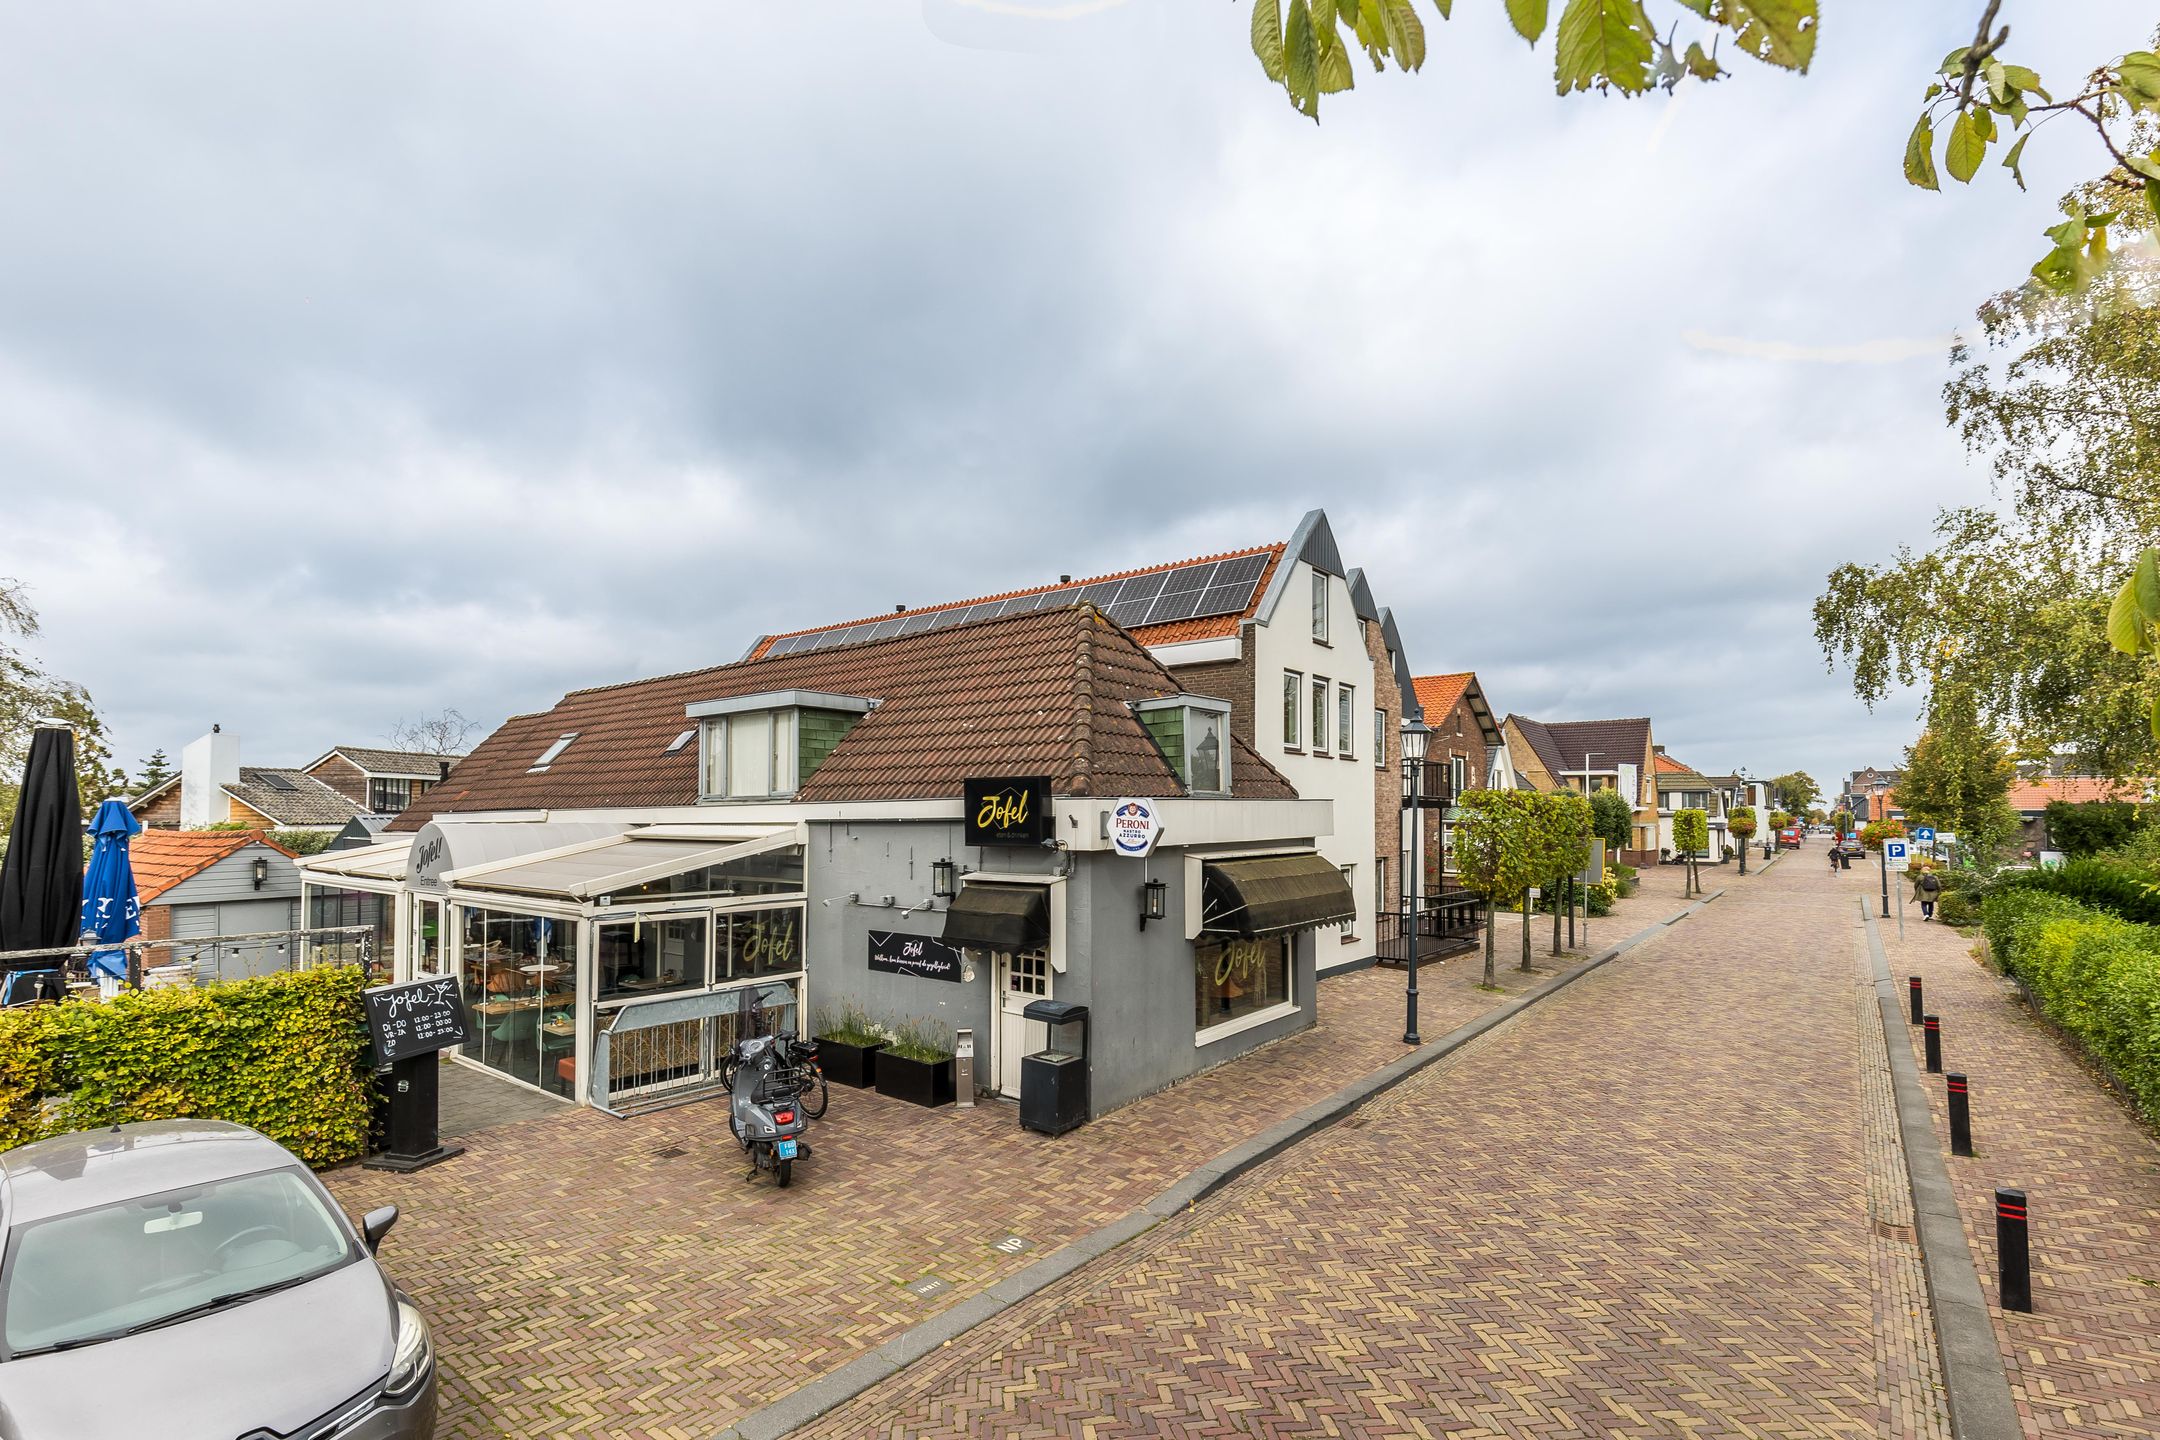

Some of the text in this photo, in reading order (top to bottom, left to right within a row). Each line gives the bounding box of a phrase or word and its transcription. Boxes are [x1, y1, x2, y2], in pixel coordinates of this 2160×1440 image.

[978, 789, 1028, 828] Jofel
[1116, 818, 1149, 830] PERONI
[1892, 845, 1902, 856] P
[420, 875, 437, 886] Entree
[743, 921, 793, 965] Jofel
[903, 942, 924, 957] Jofel
[386, 1039, 396, 1047] ZO
[997, 1238, 1023, 1253] NP
[917, 1280, 941, 1294] INRIT
